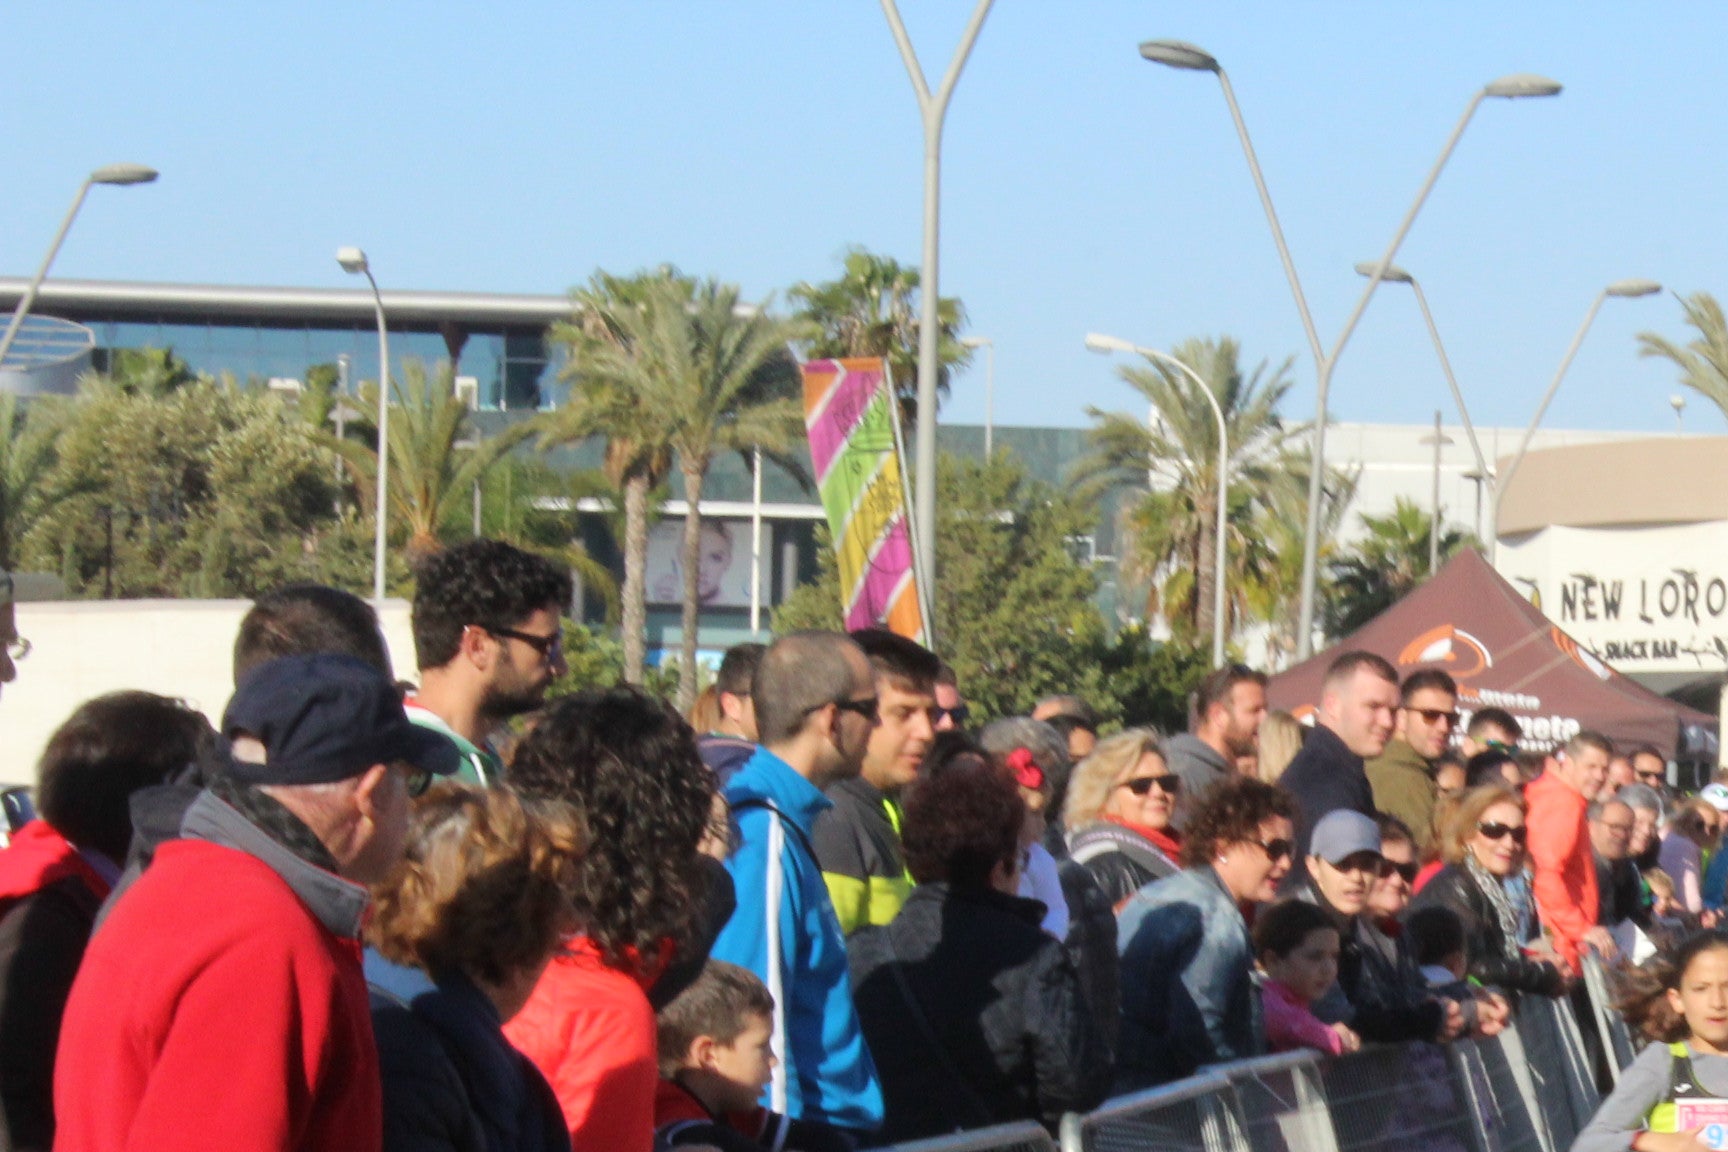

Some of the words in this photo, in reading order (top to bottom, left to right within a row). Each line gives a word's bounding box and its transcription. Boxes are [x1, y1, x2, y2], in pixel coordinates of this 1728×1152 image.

[1561, 578, 1623, 621] NEW
[1639, 576, 1727, 625] LORO
[1605, 639, 1649, 660] SNACK
[1653, 639, 1679, 659] BAR
